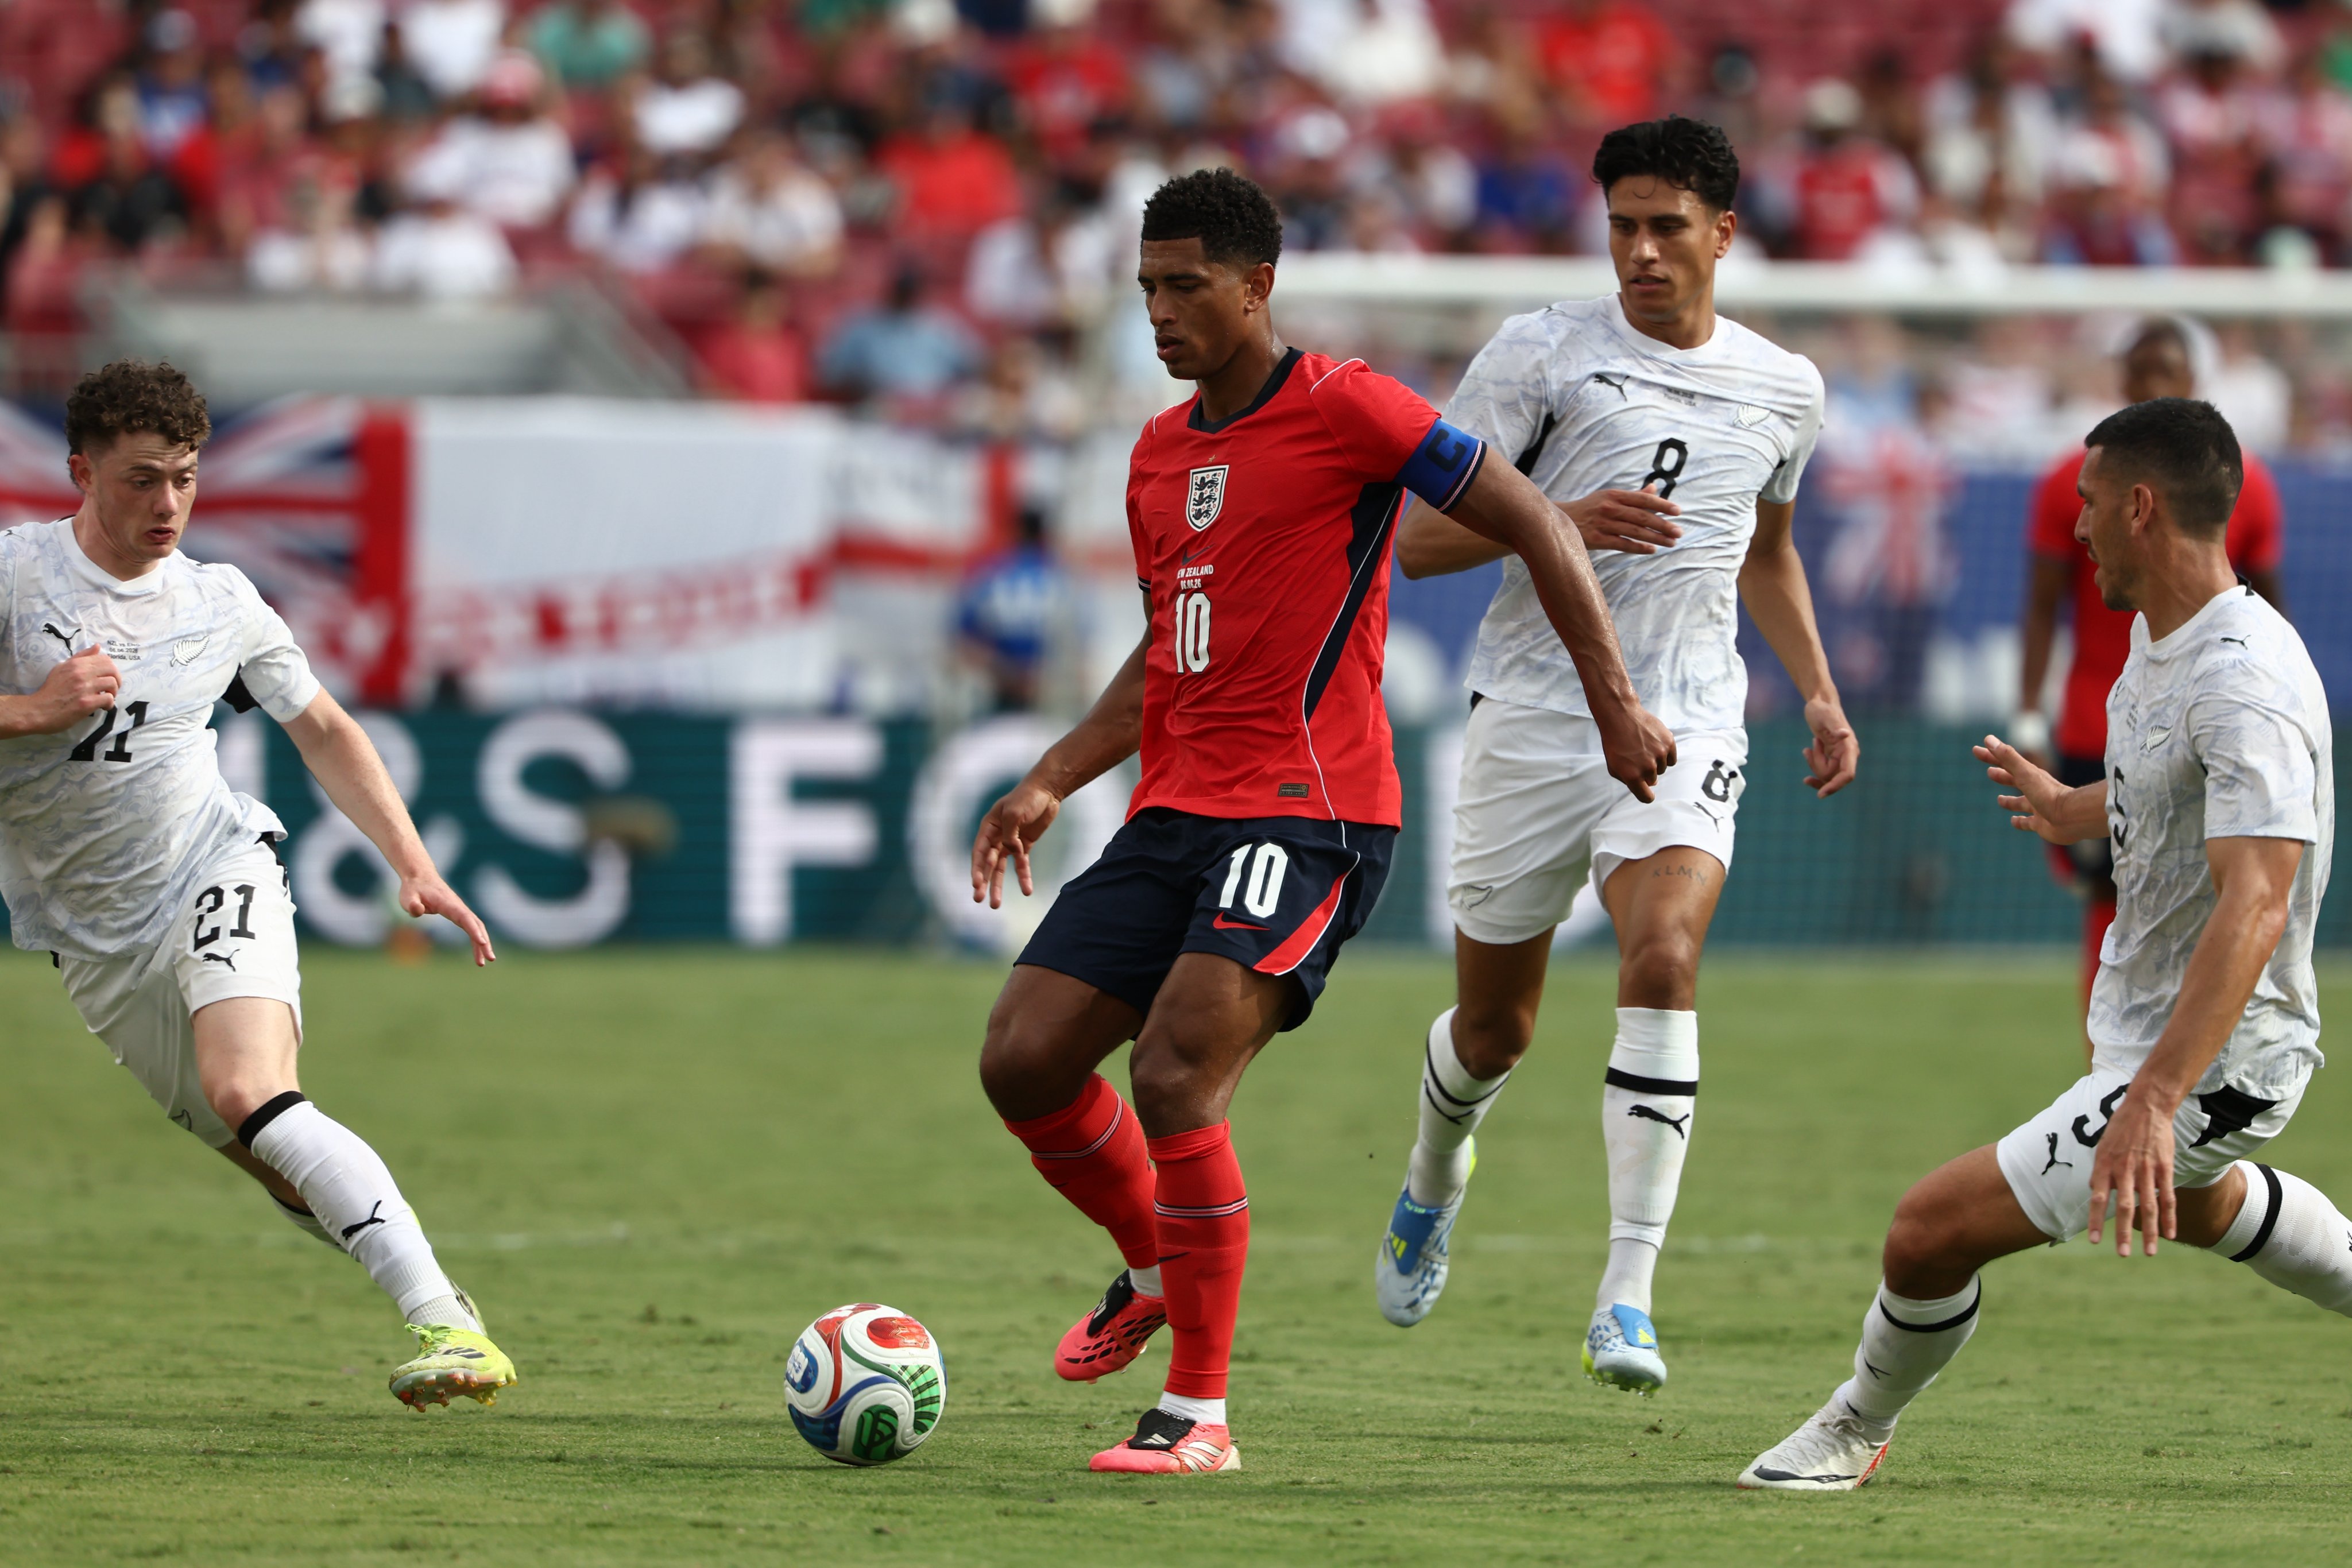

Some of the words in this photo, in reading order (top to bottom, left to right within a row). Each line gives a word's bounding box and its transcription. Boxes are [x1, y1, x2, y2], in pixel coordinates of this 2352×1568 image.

[1425, 428, 1467, 473] C
[1641, 437, 1689, 501] 8
[1177, 568, 1186, 579] EW
[1185, 564, 1214, 578] ZEALAND
[1180, 578, 1202, 590] 06.06.26
[1175, 593, 1211, 673] 10
[67, 700, 150, 763] 21
[1701, 759, 1738, 803] 8
[224, 710, 630, 947] &S
[1218, 842, 1289, 919] 10
[194, 884, 257, 953] 21
